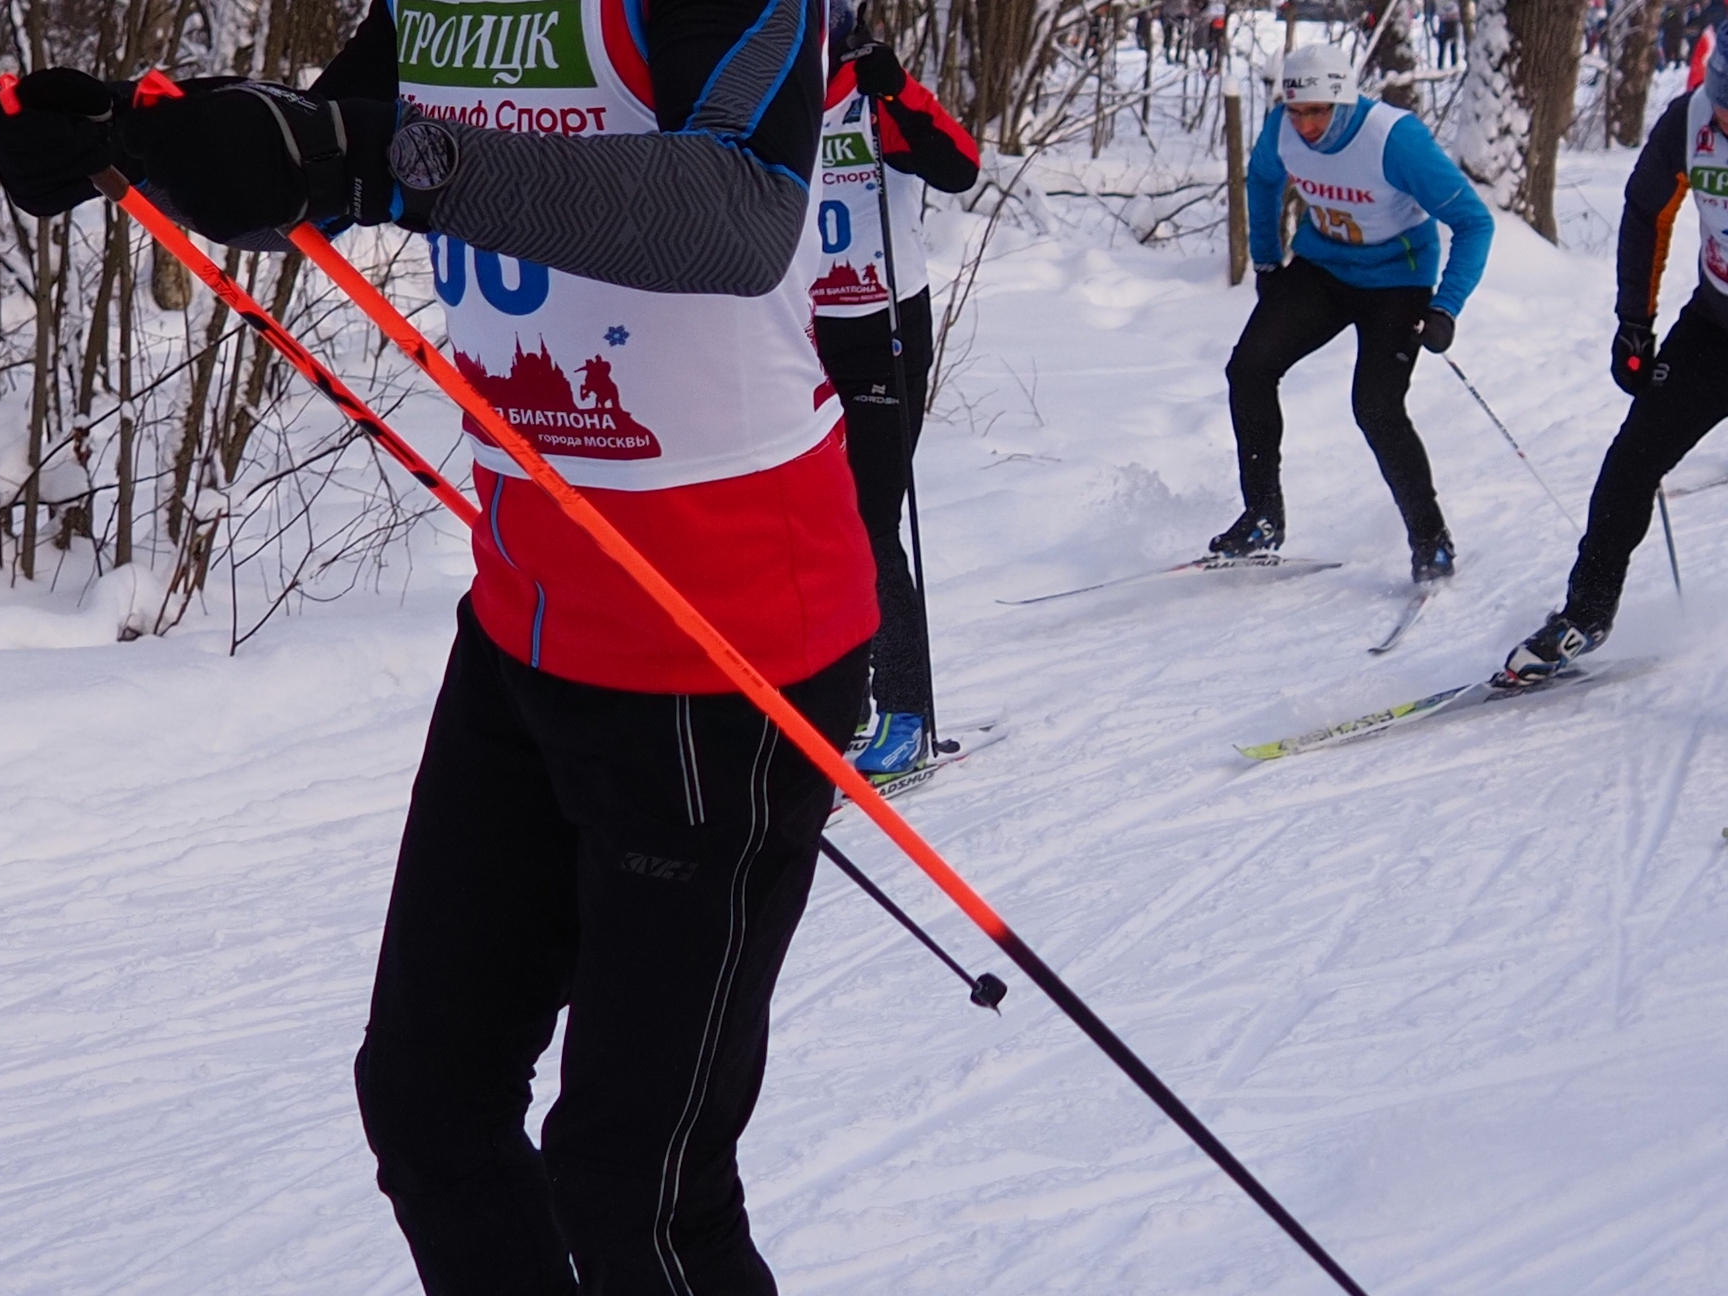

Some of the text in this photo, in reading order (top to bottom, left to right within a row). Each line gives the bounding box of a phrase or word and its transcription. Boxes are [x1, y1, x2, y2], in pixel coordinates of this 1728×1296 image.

[398, 9, 560, 84] ТРОИЦК
[508, 407, 617, 430] БИАТЛОНА
[538, 433, 651, 449] города МОСКВЫ
[874, 770, 935, 797] ADSHUS
